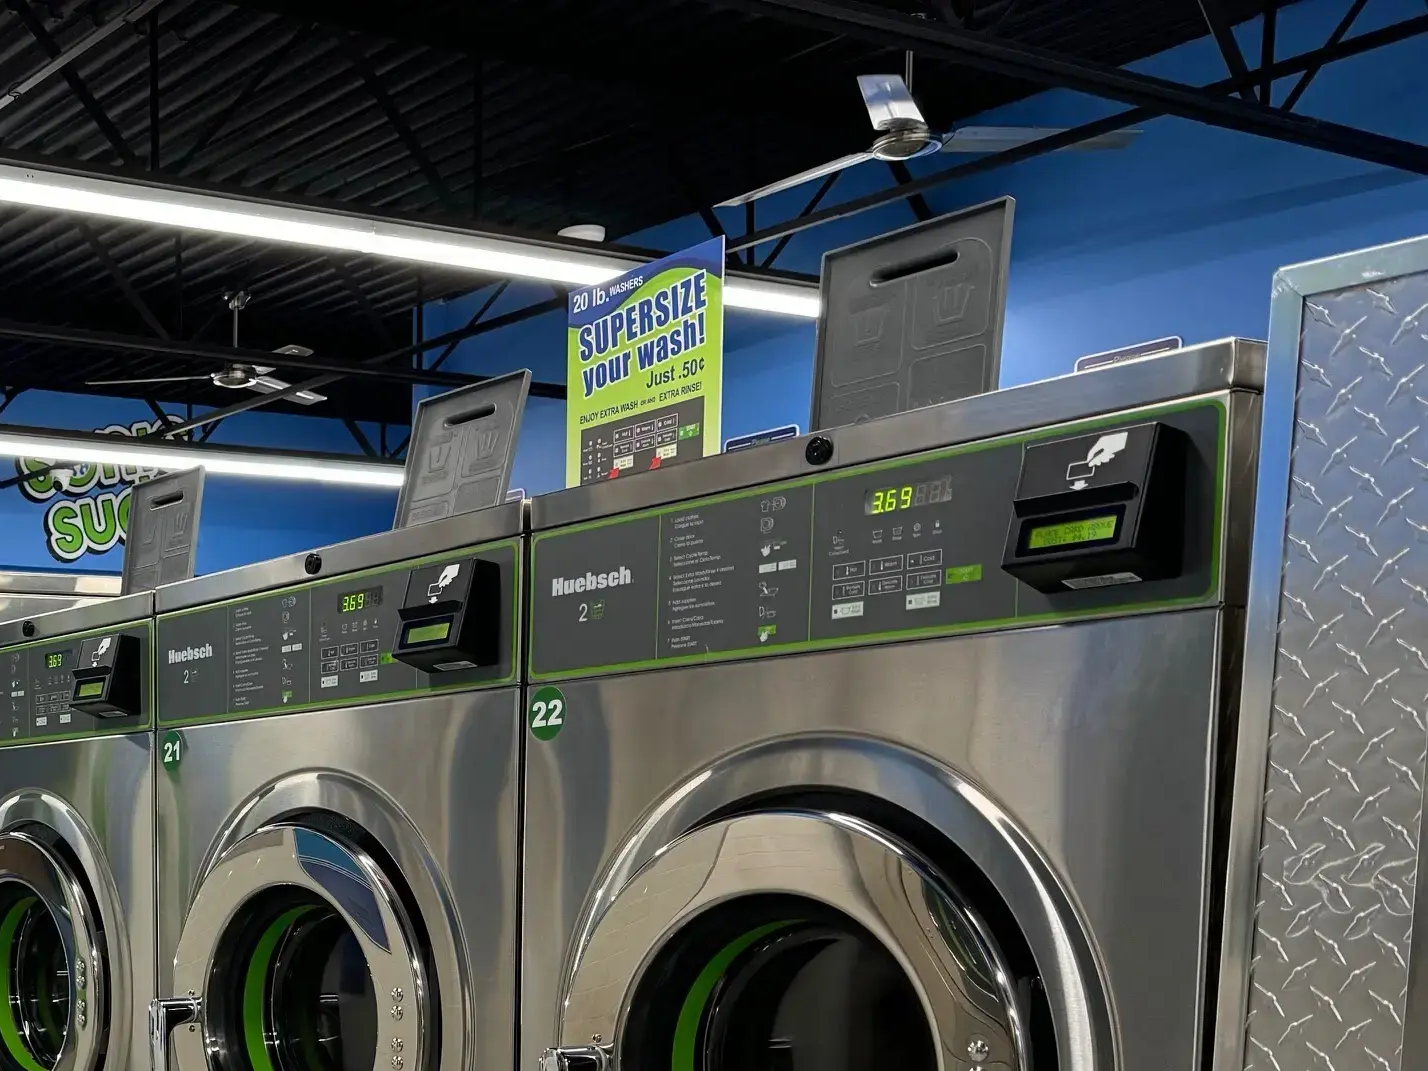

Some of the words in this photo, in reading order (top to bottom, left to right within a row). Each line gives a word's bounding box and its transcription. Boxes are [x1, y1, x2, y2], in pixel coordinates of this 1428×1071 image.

[573, 293, 588, 314] 20
[593, 288, 609, 307] lb.
[609, 276, 644, 297] WASHERS
[578, 268, 708, 363] SUPERSIZE
[582, 349, 632, 399] your
[636, 310, 707, 372] wash!
[646, 365, 675, 389] Just
[579, 411, 599, 425] ENJOY
[599, 406, 620, 418] EXTRA
[620, 400, 638, 413] WASH
[659, 389, 680, 402] EXTRA
[681, 381, 702, 395] RINSE!
[872, 486, 913, 514] 3.69
[551, 566, 632, 597] Huebsch
[578, 603, 588, 622] 2
[168, 643, 213, 665] Huebsch
[183, 670, 189, 684] 2
[531, 699, 563, 728] 22
[164, 739, 181, 763] 21
